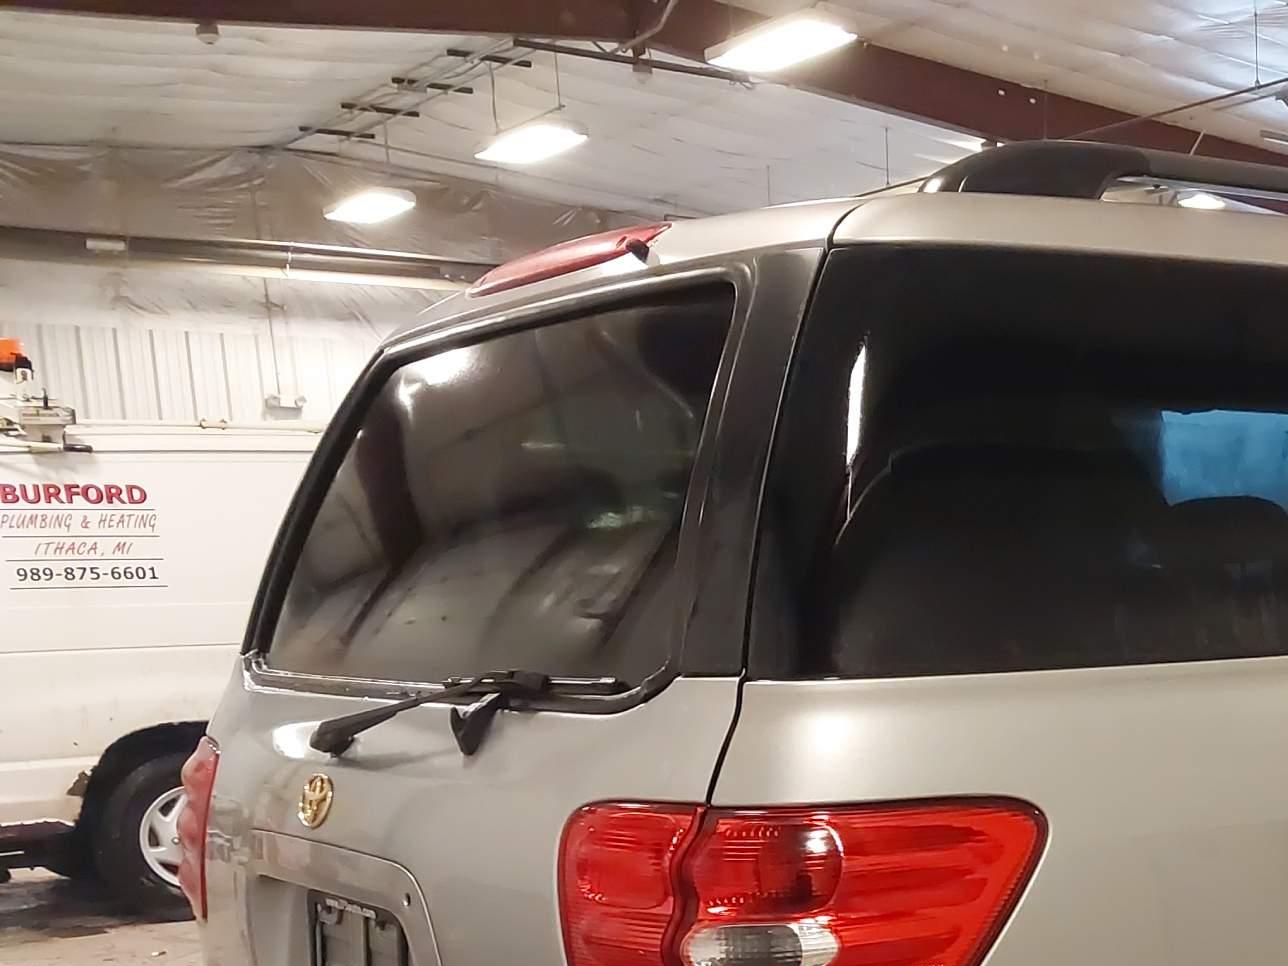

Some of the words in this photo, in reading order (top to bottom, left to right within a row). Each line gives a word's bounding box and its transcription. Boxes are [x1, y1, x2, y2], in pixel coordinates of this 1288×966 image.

[0, 483, 148, 505] BURFORD
[0, 514, 73, 533] PLUMBING
[80, 514, 91, 529] &
[98, 513, 157, 533] HEATING
[34, 541, 105, 557] ITHACA,
[112, 541, 133, 555] MI
[16, 566, 160, 581] 989-875-6601
